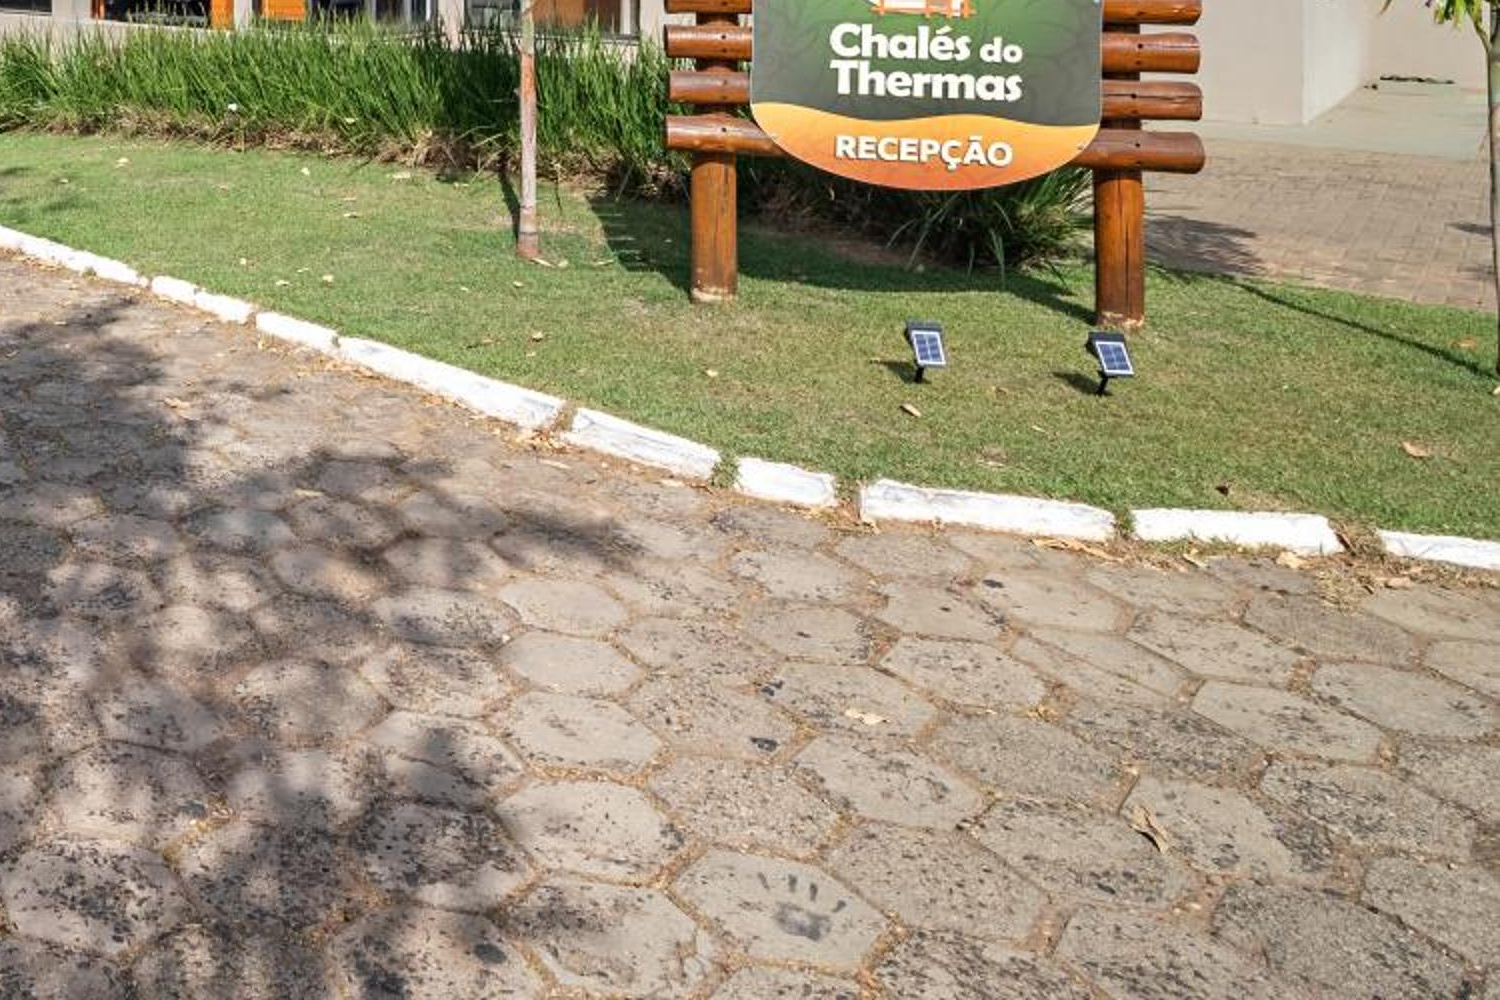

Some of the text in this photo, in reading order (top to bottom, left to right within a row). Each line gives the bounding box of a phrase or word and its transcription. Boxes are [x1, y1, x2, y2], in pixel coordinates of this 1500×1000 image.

[830, 22, 1023, 63] Chalés do
[830, 59, 1023, 102] Thermas
[835, 134, 1013, 170] RECEPÇÃO
